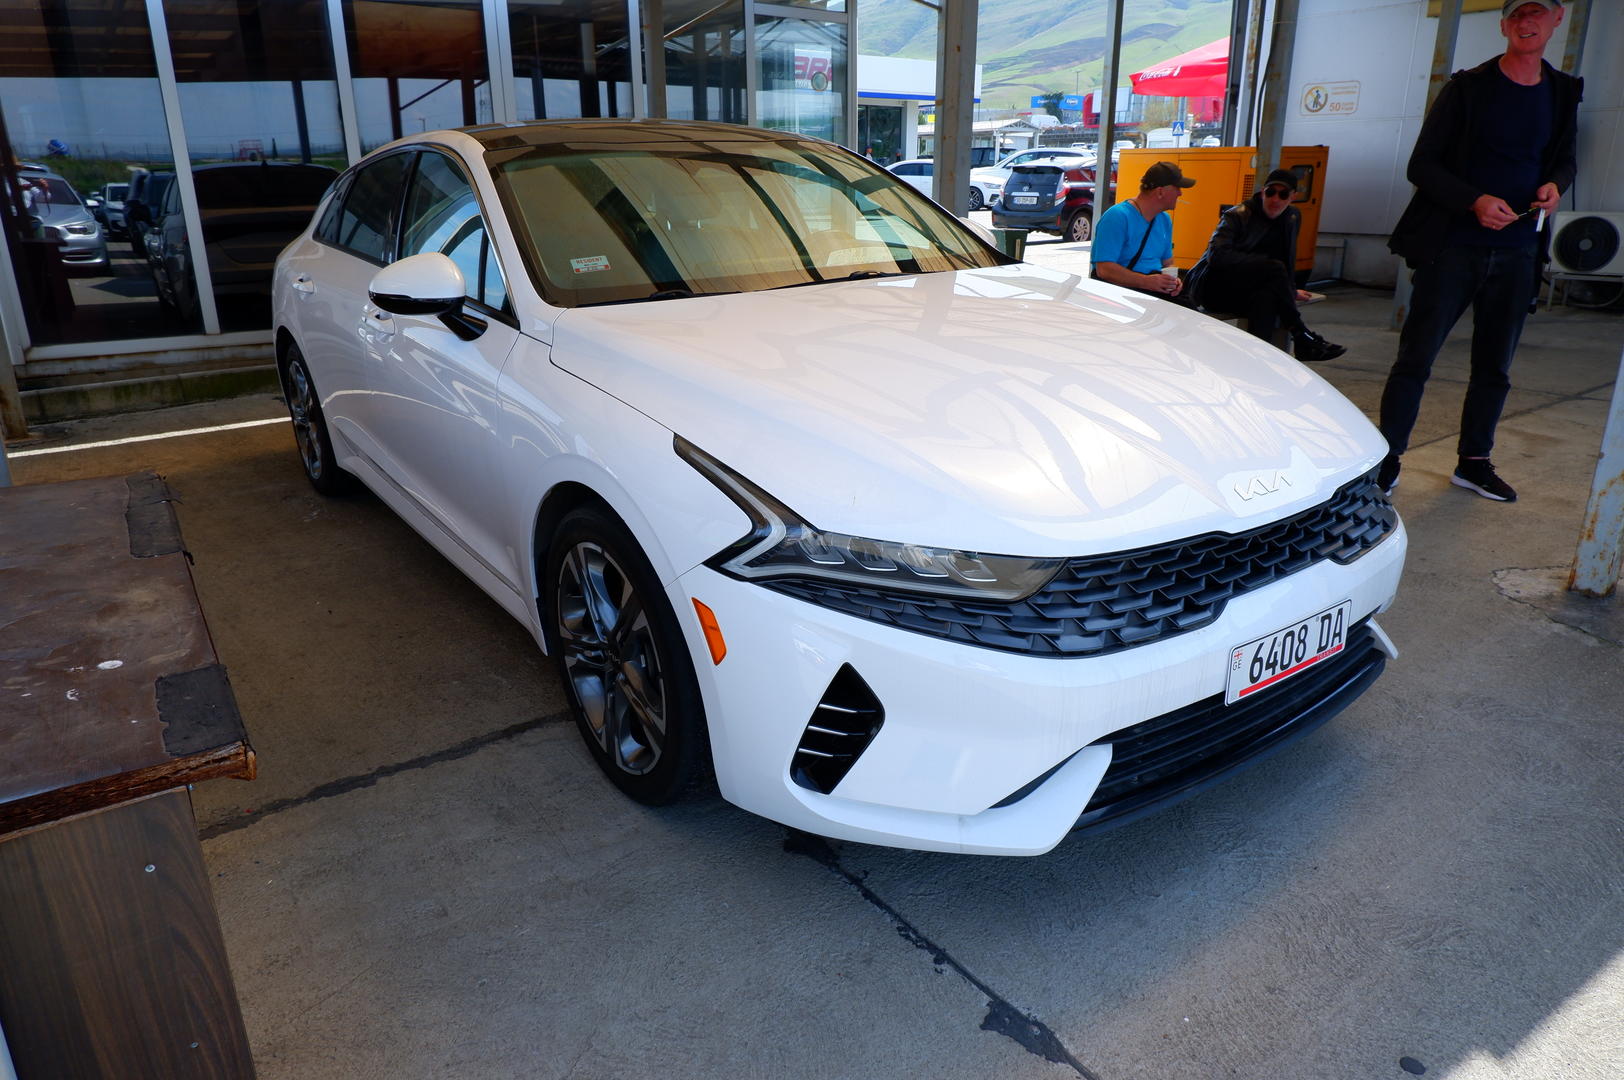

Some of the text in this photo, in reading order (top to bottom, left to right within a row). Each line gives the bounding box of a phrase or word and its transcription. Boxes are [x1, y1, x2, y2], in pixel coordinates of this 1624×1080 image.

[1233, 470, 1293, 501] KIA
[1249, 607, 1344, 684] 6408 DA
[1232, 660, 1242, 671] GE
